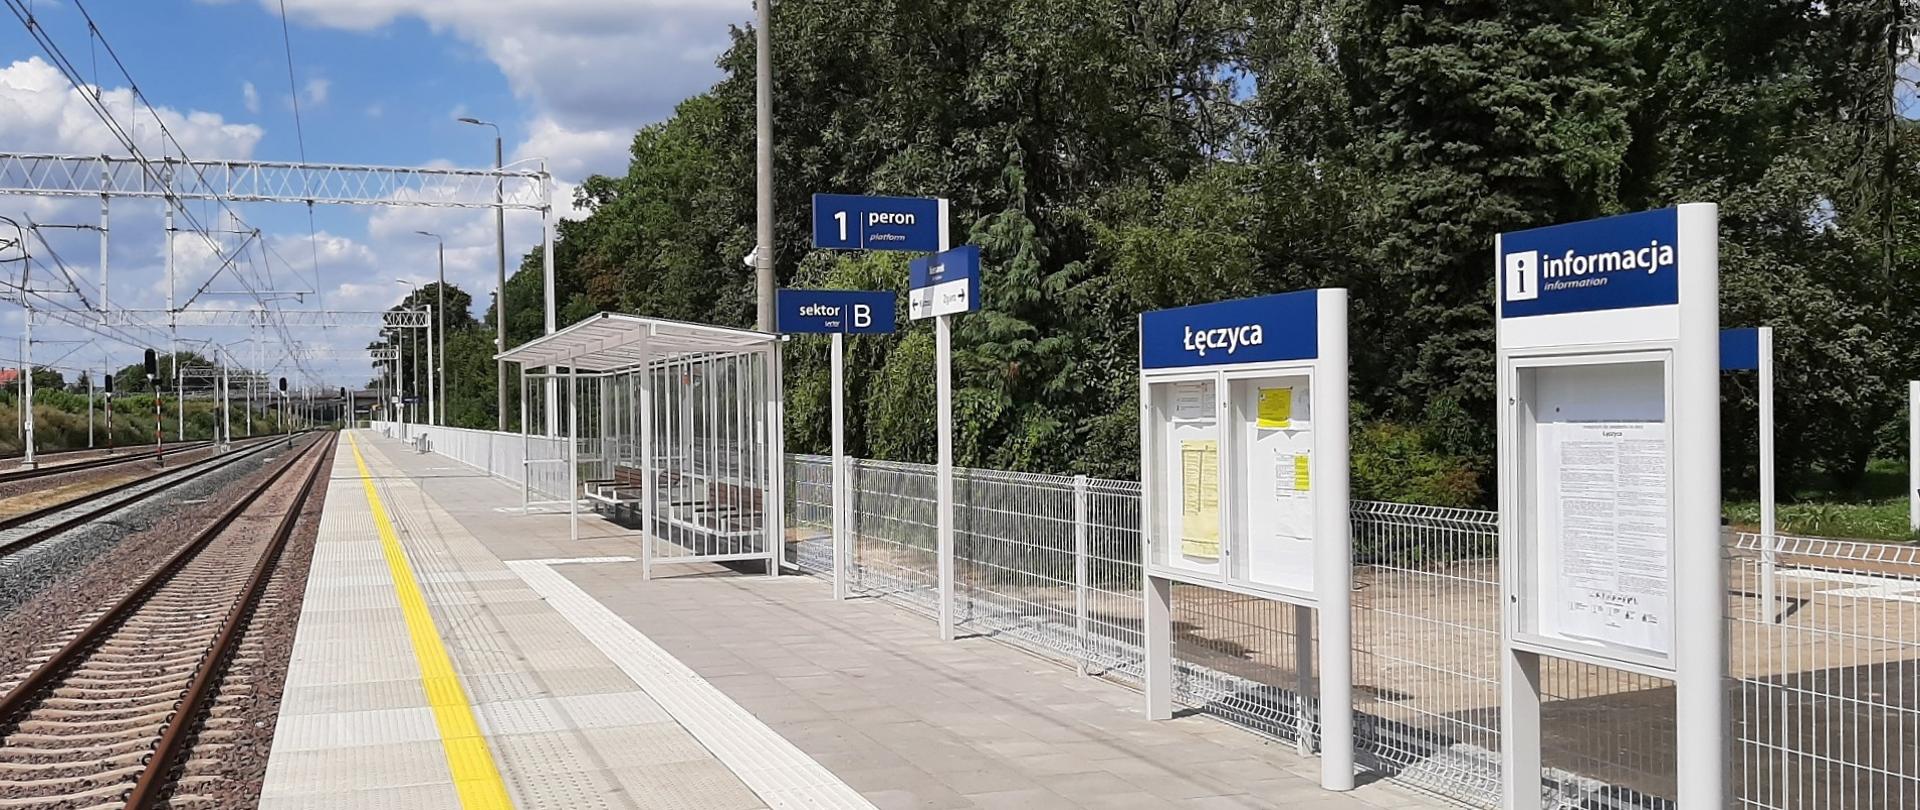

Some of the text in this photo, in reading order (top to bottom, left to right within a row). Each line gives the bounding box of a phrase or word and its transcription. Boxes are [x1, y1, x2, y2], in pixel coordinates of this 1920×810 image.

[834, 211, 915, 241] 1 peron
[869, 232, 906, 242] platform
[1543, 239, 1674, 279] informacja
[1543, 276, 1608, 291] information
[799, 303, 872, 328] sektor B
[1183, 324, 1263, 357] Łęczyca
